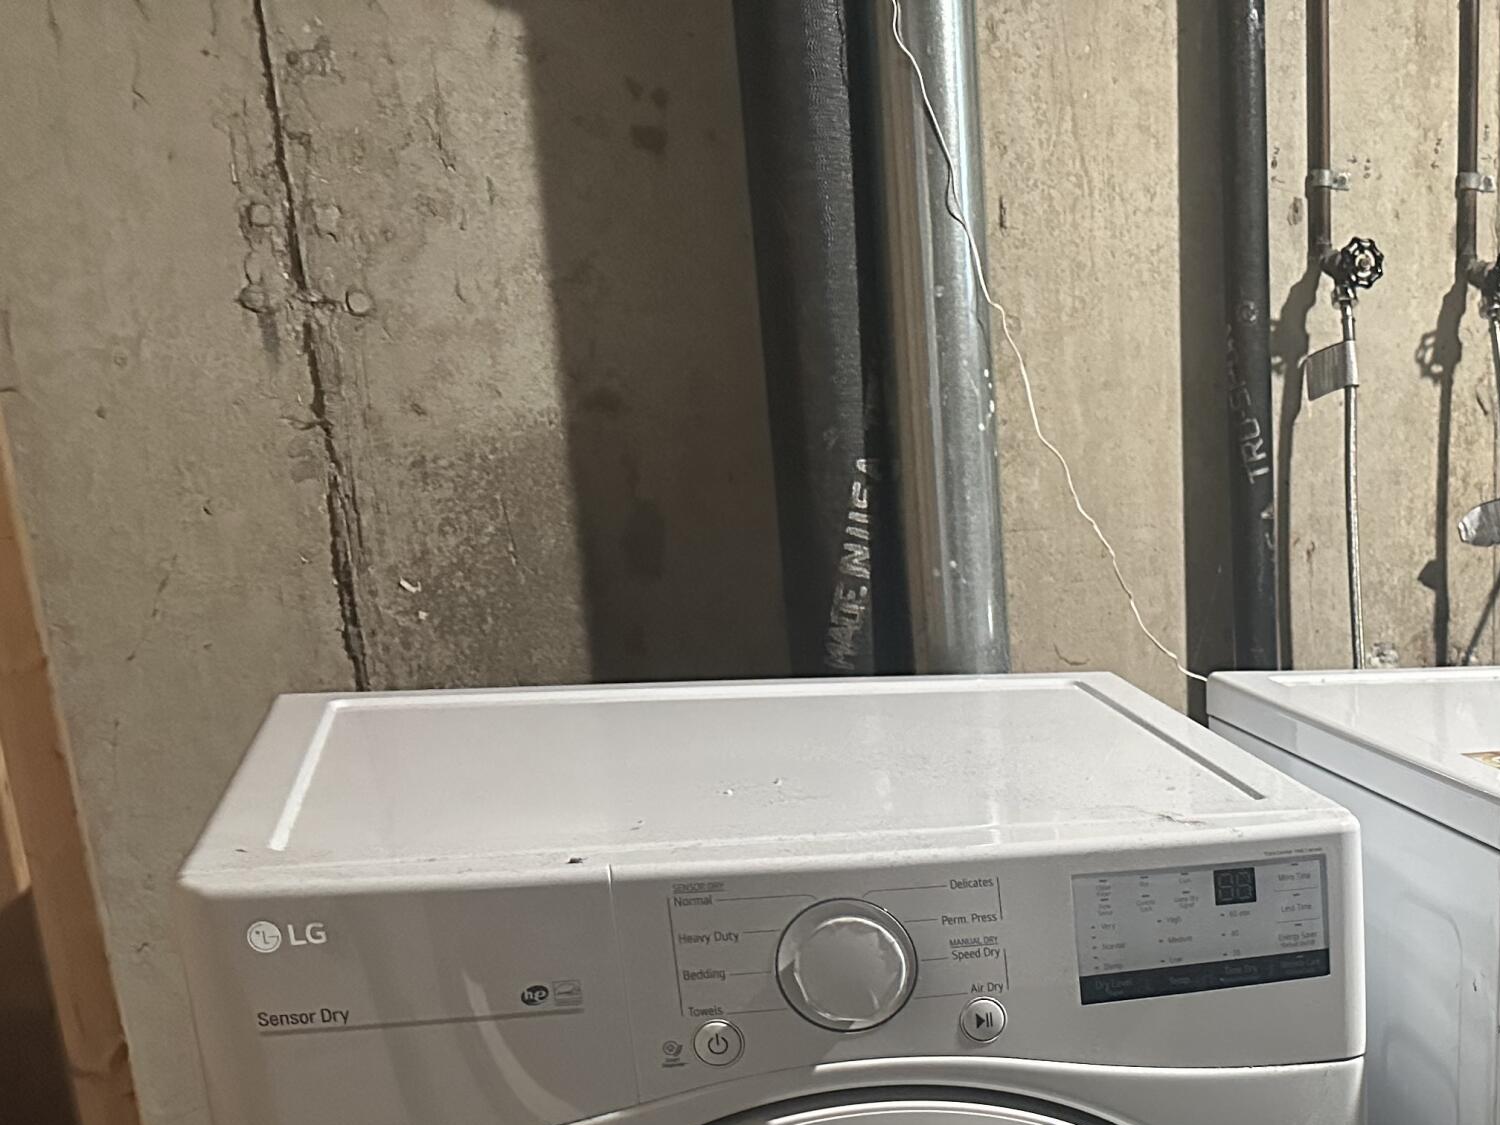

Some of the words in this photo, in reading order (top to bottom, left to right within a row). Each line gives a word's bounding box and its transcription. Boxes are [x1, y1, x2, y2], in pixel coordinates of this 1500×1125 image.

[950, 878, 994, 890] Delicates
[674, 895, 712, 907] Normal
[971, 912, 998, 924] Press
[288, 922, 328, 947] LG
[678, 933, 711, 948] Heavy
[714, 930, 740, 944] Duty
[951, 949, 981, 962] Speed
[982, 947, 1001, 960] Dry
[683, 968, 727, 983] Bedding
[970, 982, 985, 993] Air
[986, 981, 1005, 995] Dry
[257, 1009, 317, 1028] Sensor
[320, 1007, 349, 1027] Dry
[688, 1005, 724, 1018] Towels
